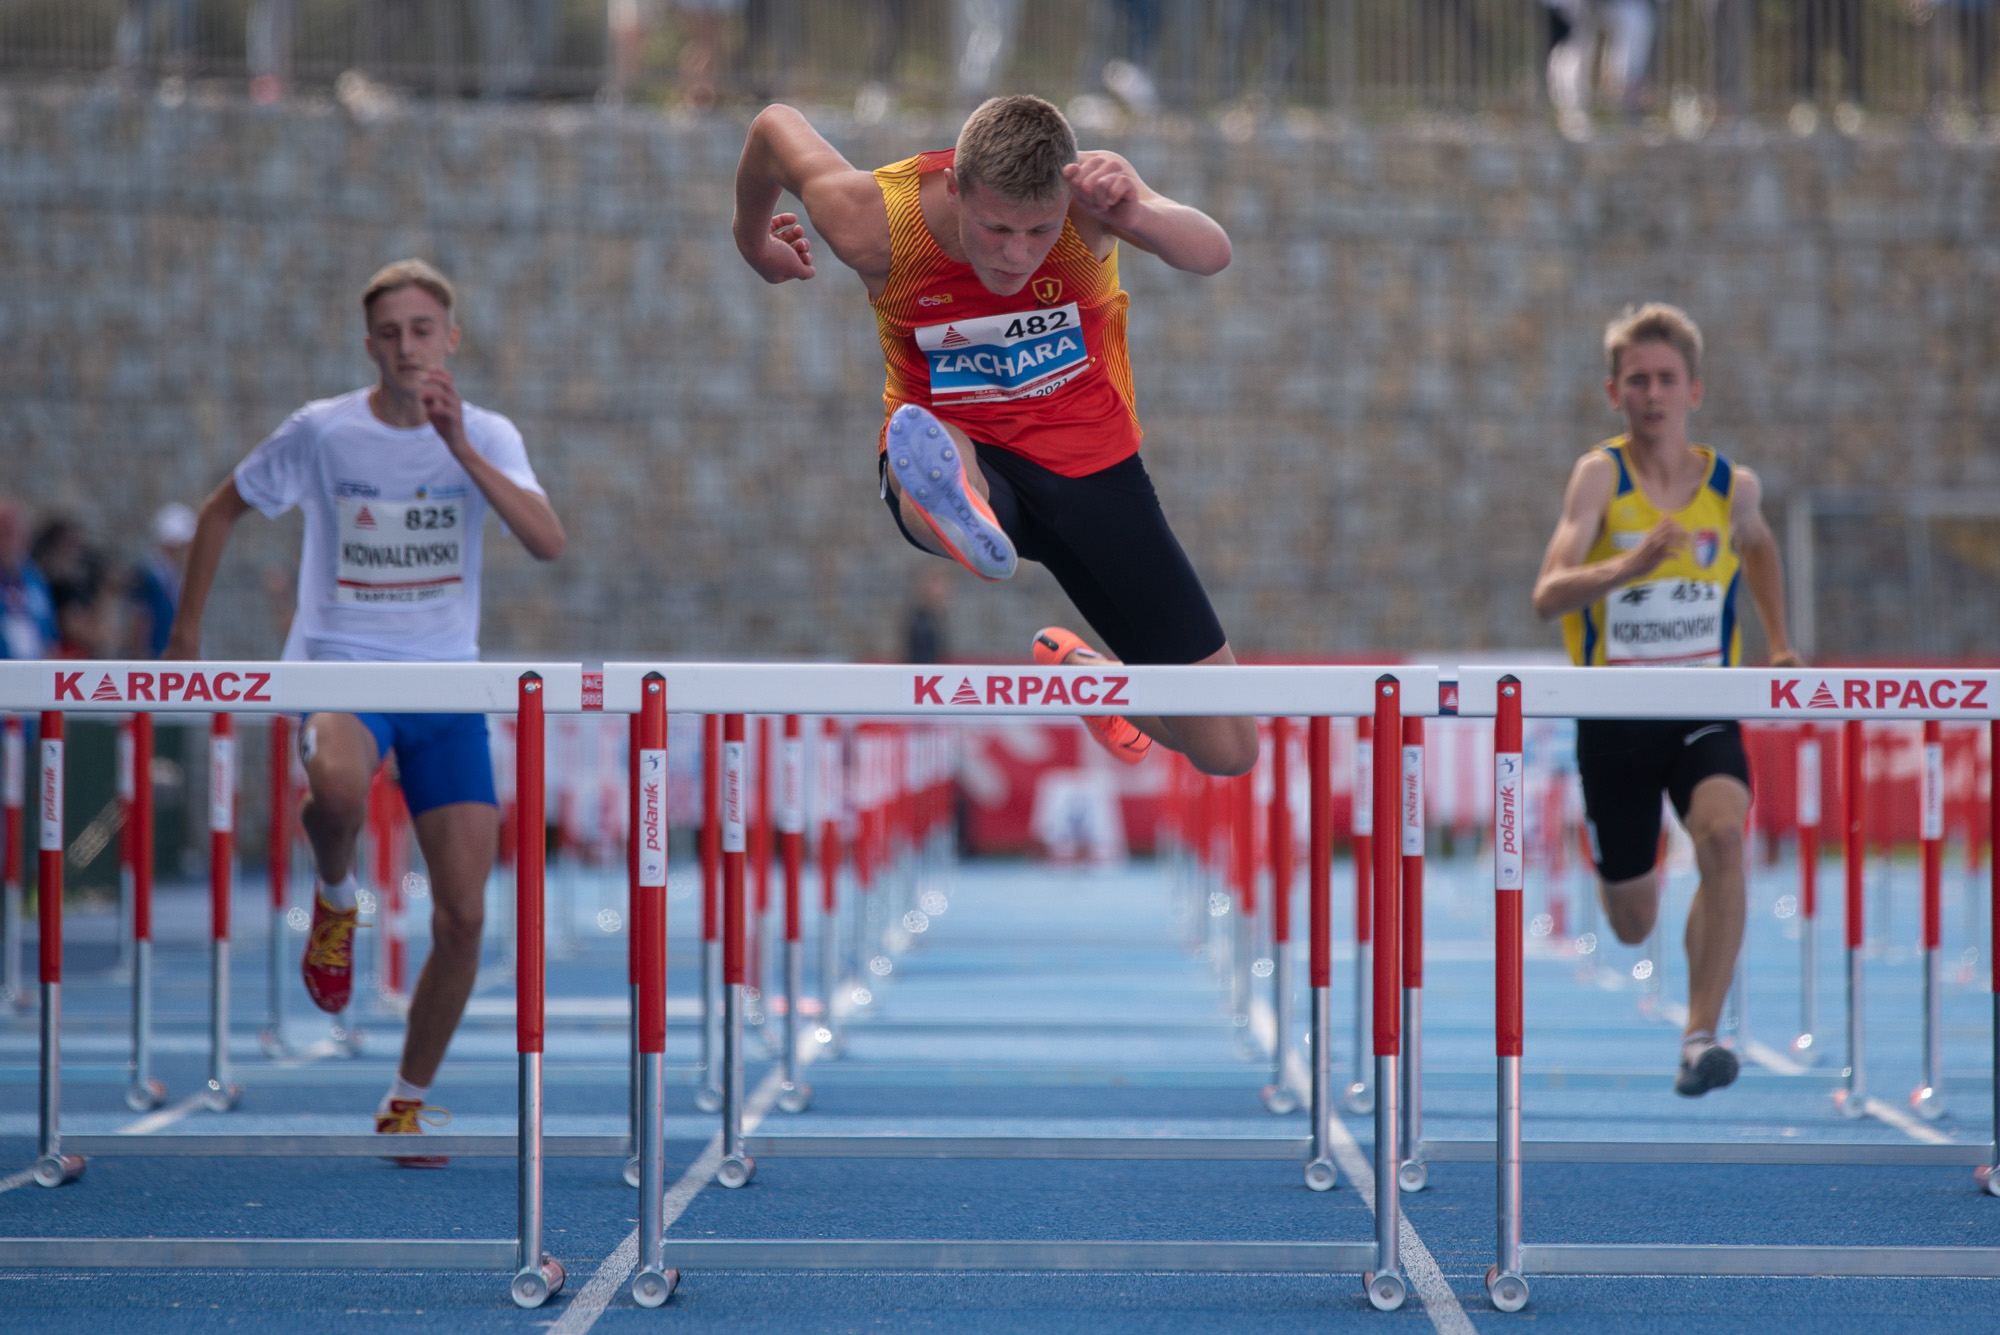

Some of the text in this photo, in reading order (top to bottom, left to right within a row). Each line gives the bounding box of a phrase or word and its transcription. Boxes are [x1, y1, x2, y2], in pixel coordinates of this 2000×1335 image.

[1004, 311, 1070, 339] 482
[933, 336, 1078, 377] ZACHARA
[405, 506, 457, 531] 825
[342, 543, 460, 568] KOWALEWSKI
[54, 672, 271, 702] KARPACZ
[914, 675, 1129, 706] KARPACZ
[1770, 679, 1988, 709] KARPACZ
[44, 767, 57, 823] polanik
[727, 769, 741, 824] polanik
[1406, 773, 1419, 828] polanik
[646, 781, 661, 852] polanik
[1502, 784, 1518, 855] polanik
